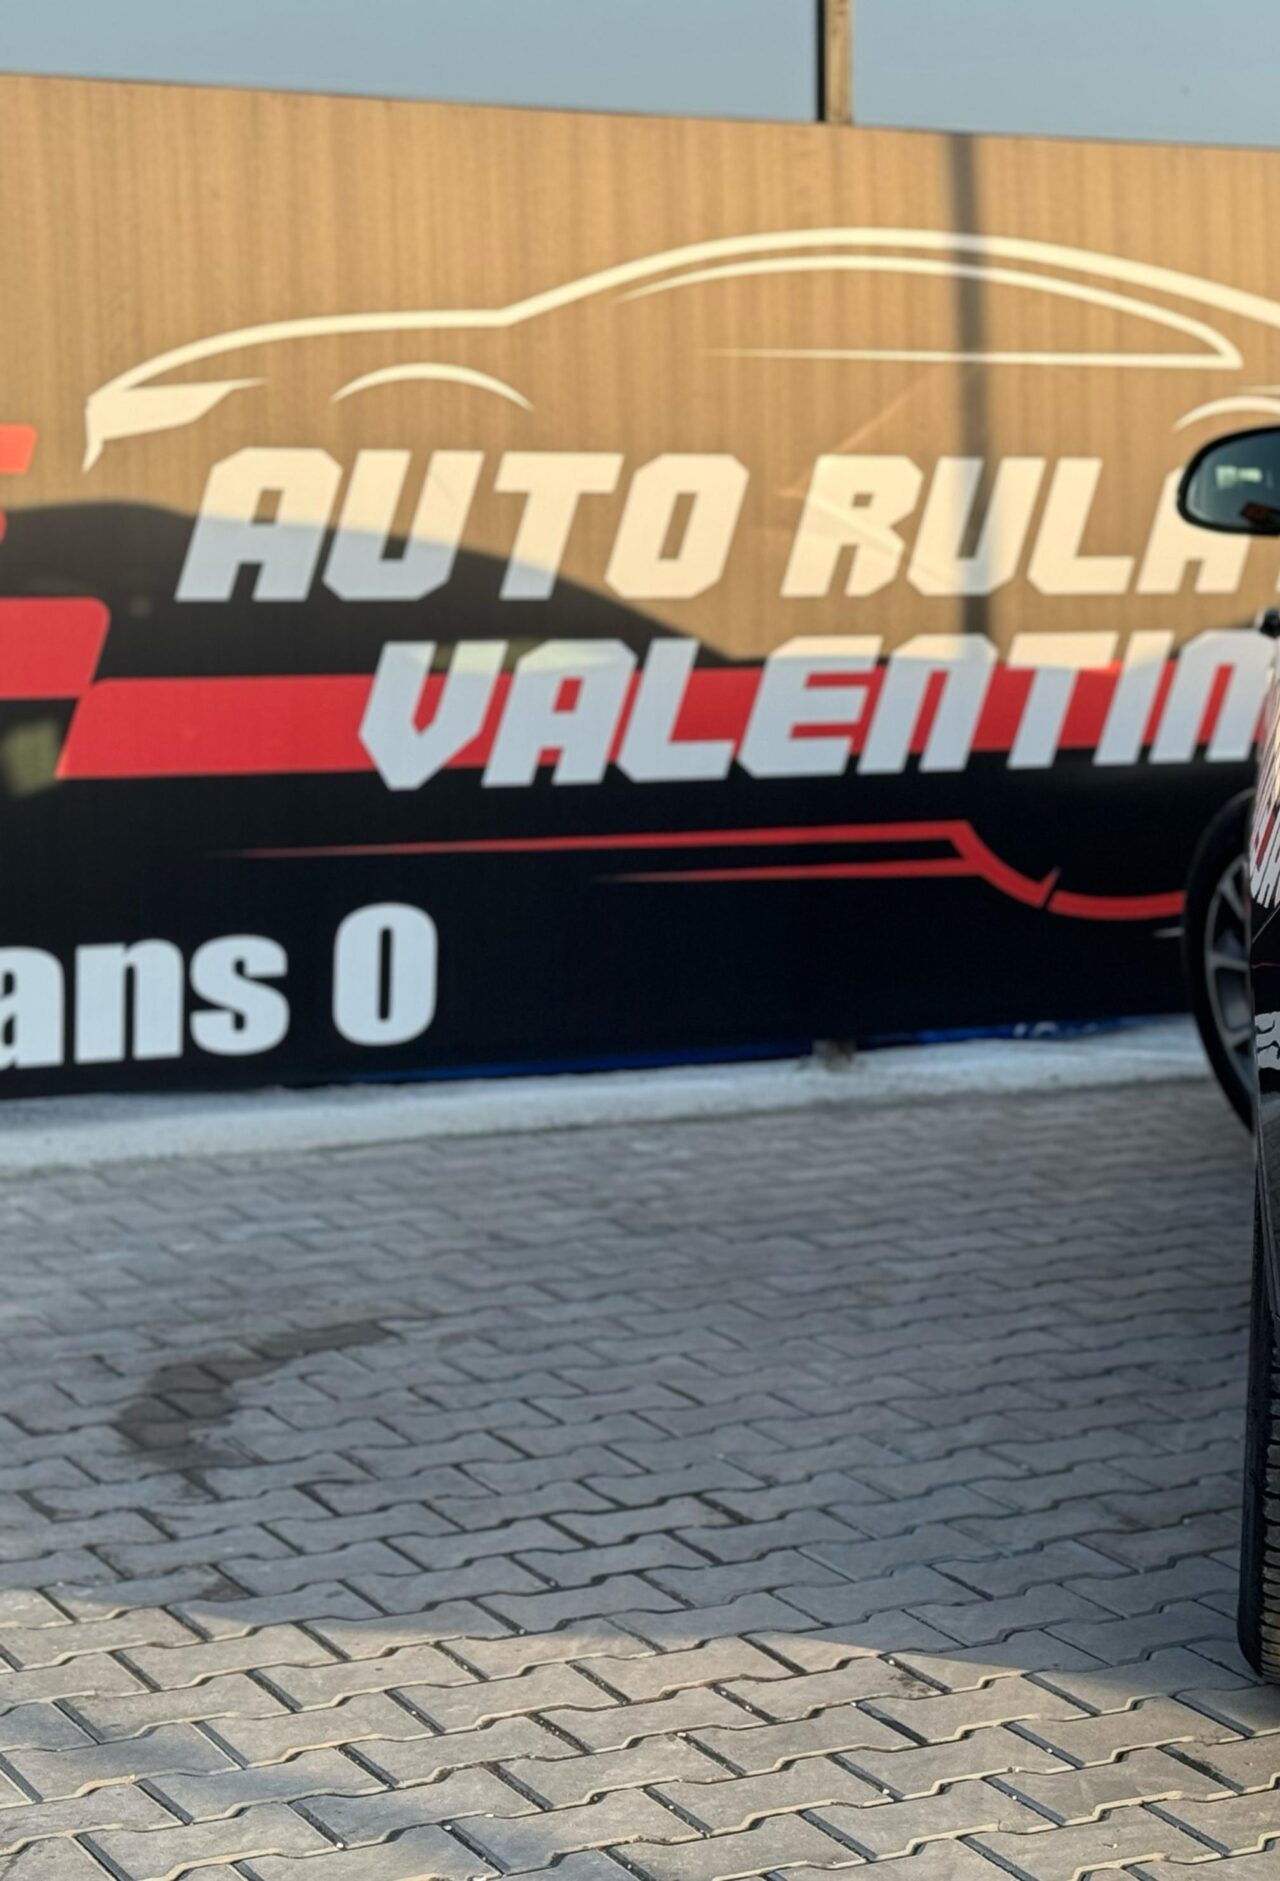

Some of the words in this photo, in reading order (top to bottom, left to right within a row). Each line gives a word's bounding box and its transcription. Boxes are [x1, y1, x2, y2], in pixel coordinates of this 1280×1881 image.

[174, 446, 750, 602] AUTO
[358, 629, 1279, 791] VALENTIN
[0, 934, 291, 1070] ans
